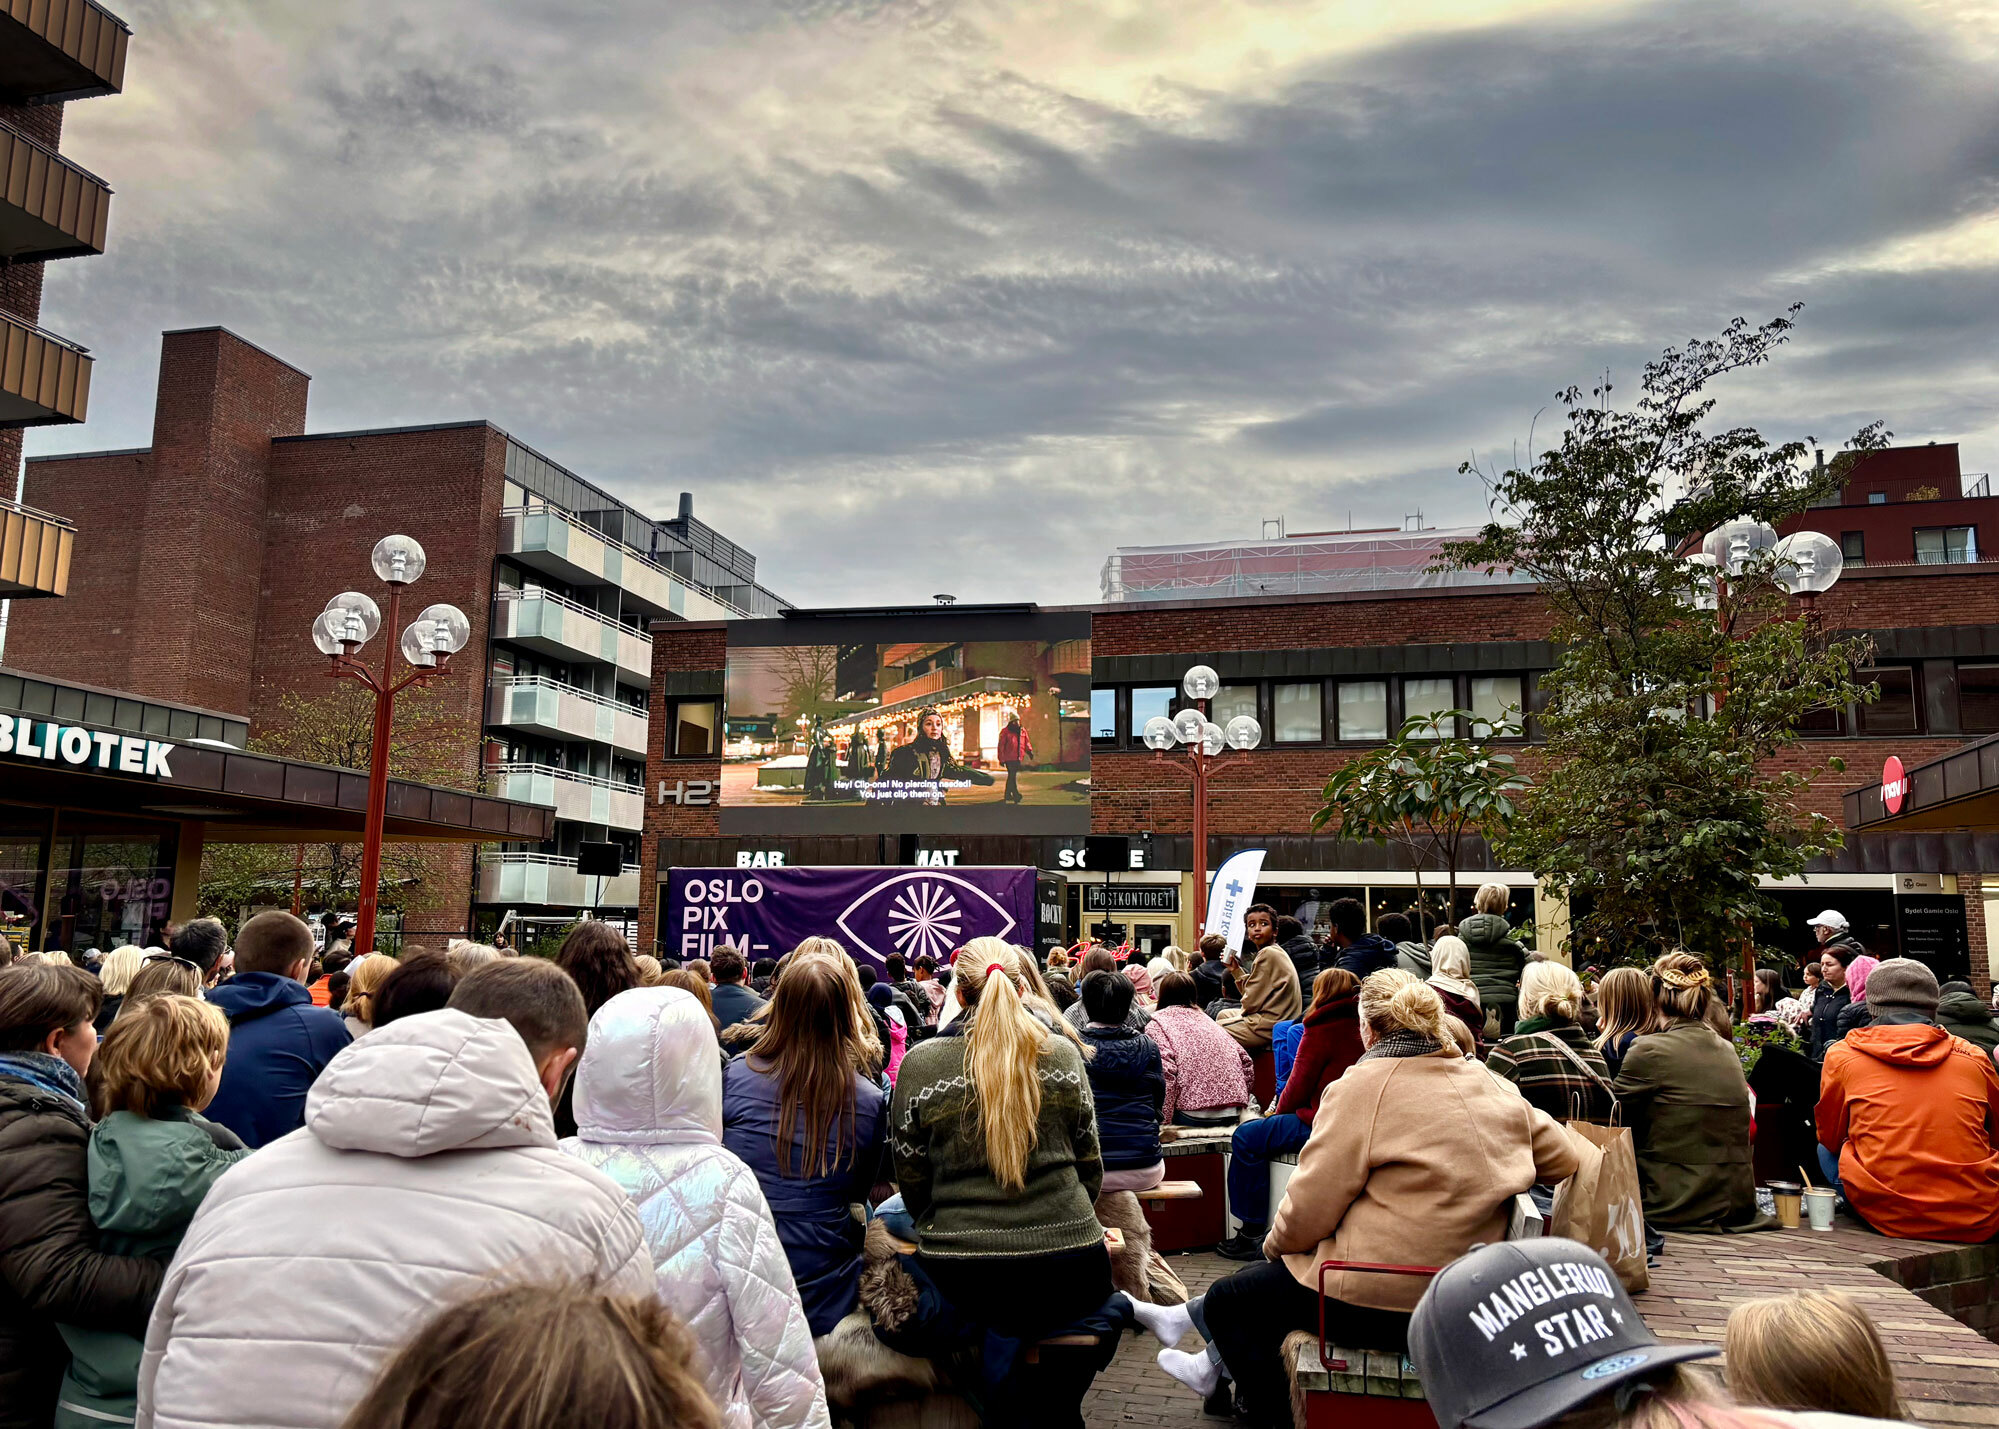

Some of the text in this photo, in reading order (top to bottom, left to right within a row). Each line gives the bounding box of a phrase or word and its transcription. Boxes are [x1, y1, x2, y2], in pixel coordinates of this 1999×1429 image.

[833, 779, 972, 790] Hey! Clip-ons! No piercing needed!
[859, 789, 945, 799] You just clip them on.
[736, 851, 785, 868] BAR
[684, 879, 764, 903] OSLO
[1093, 892, 1170, 907] POSTKONTORET
[682, 906, 729, 930] PIX
[1904, 907, 1923, 915] Bydel
[1469, 1263, 1615, 1342] MANGLERUD
[1534, 1304, 1614, 1357] STAR
